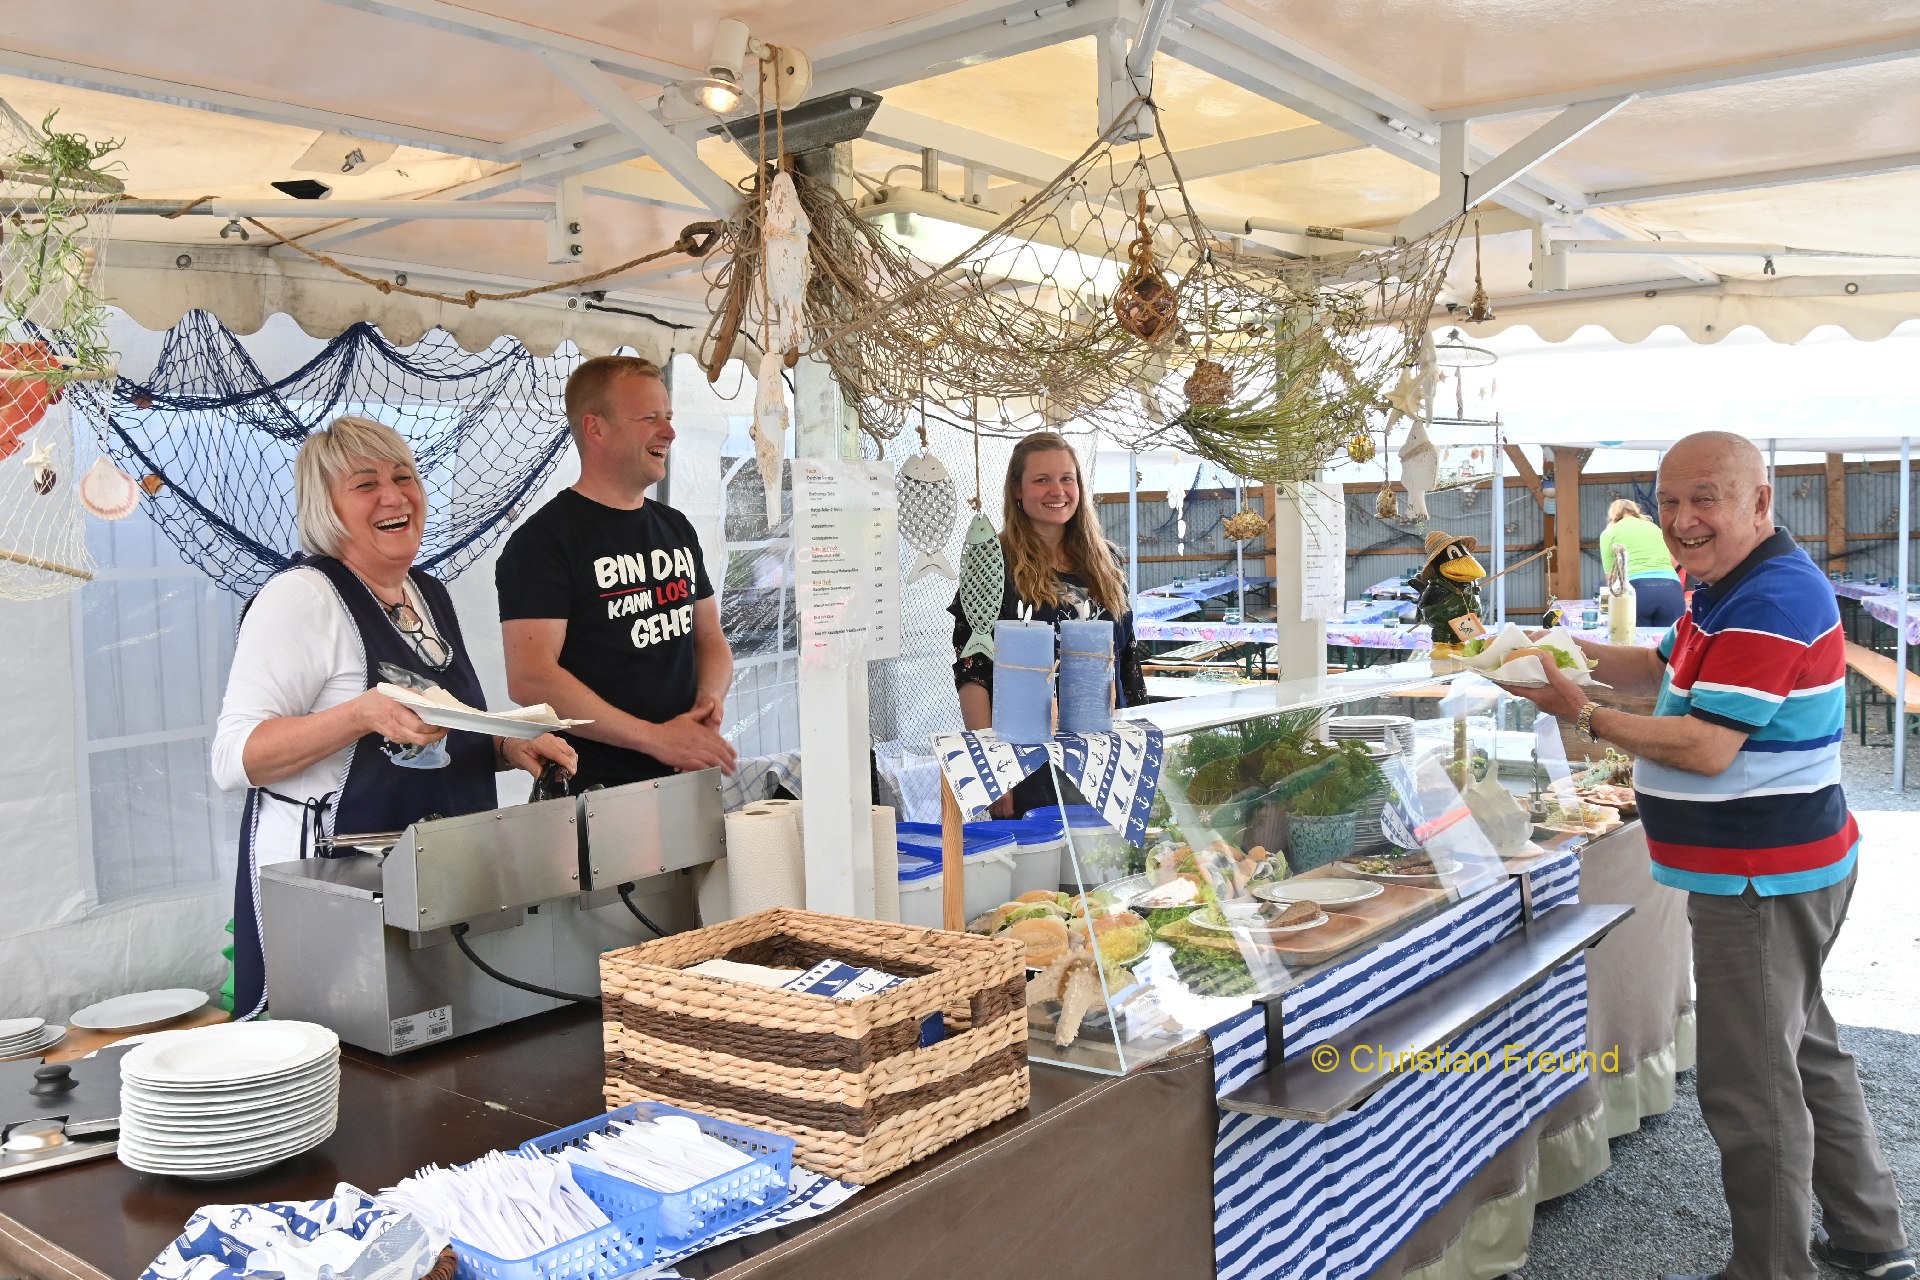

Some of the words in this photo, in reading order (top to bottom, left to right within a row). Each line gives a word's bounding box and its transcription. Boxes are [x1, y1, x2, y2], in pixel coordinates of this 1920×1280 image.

[594, 552, 646, 589] BIN
[650, 546, 696, 595] DA!
[608, 589, 653, 620] KANN
[655, 578, 689, 606] LOS
[630, 604, 694, 649] GEHE
